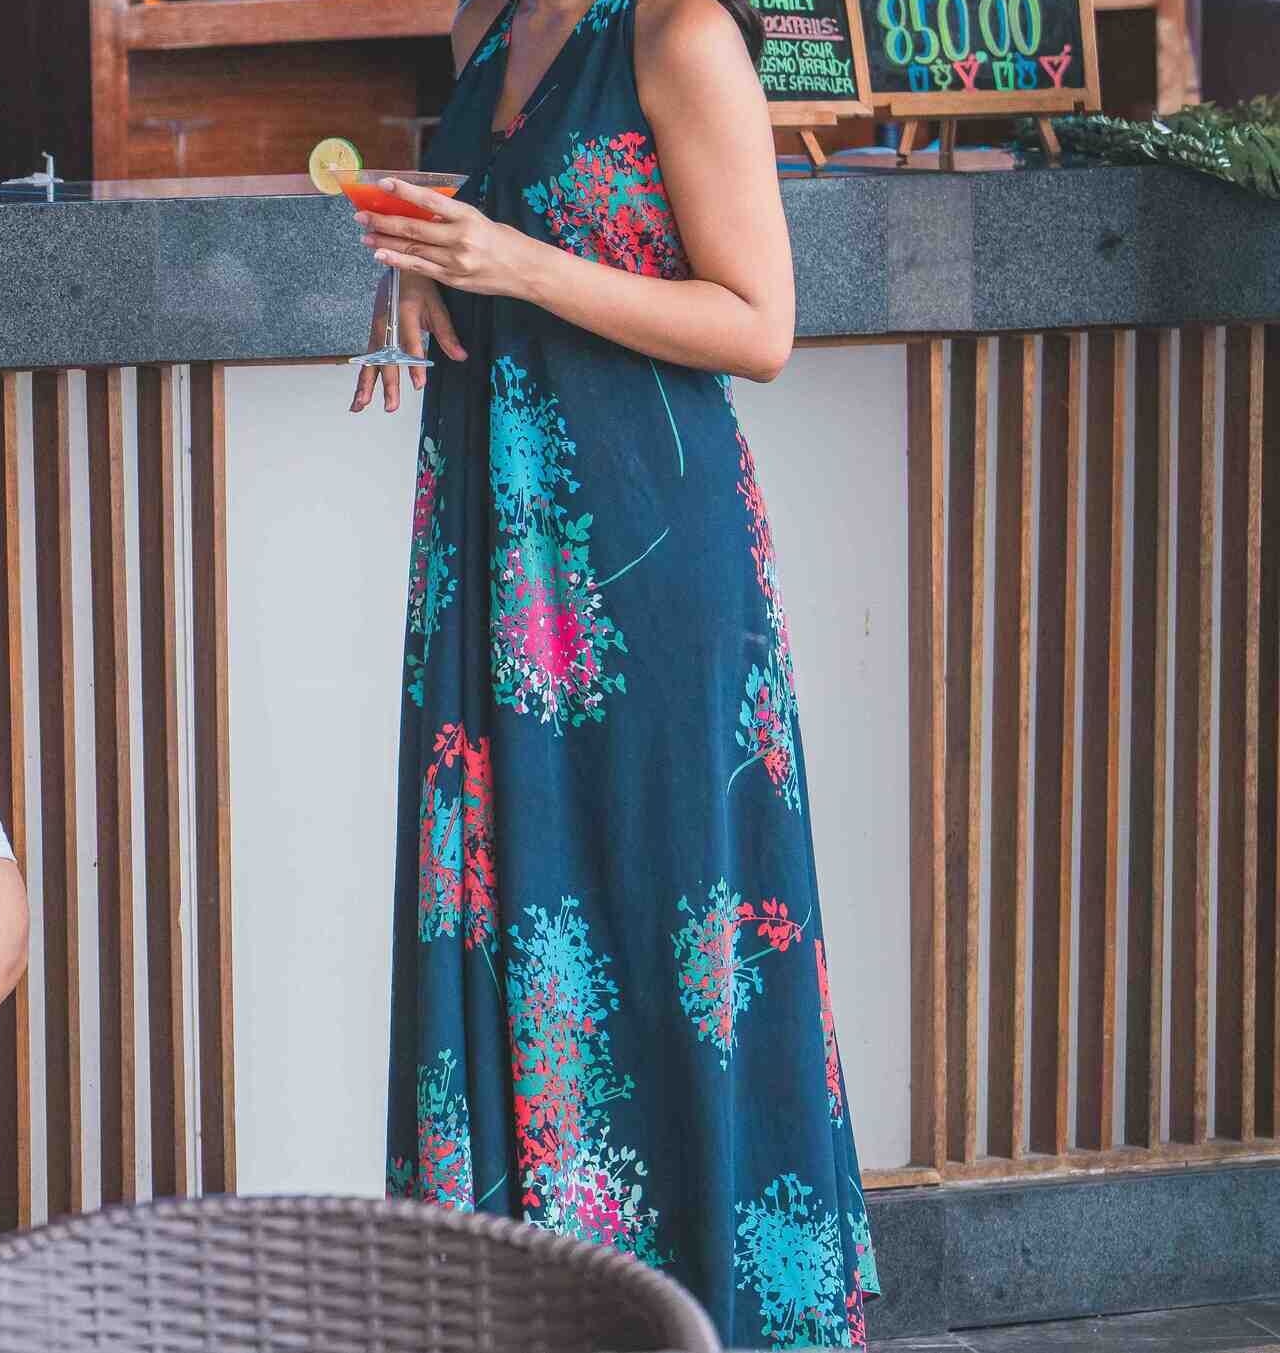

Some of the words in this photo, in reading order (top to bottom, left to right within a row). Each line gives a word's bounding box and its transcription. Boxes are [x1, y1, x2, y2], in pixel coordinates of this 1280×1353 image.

[762, 14, 840, 33] OCKTAILS:
[765, 41, 800, 61] ANDY
[801, 41, 834, 58] SOUR
[760, 56, 796, 72] OSMO
[799, 58, 851, 76] BRANDY
[760, 74, 788, 91] PPLE
[789, 75, 855, 94] SPARKLER
